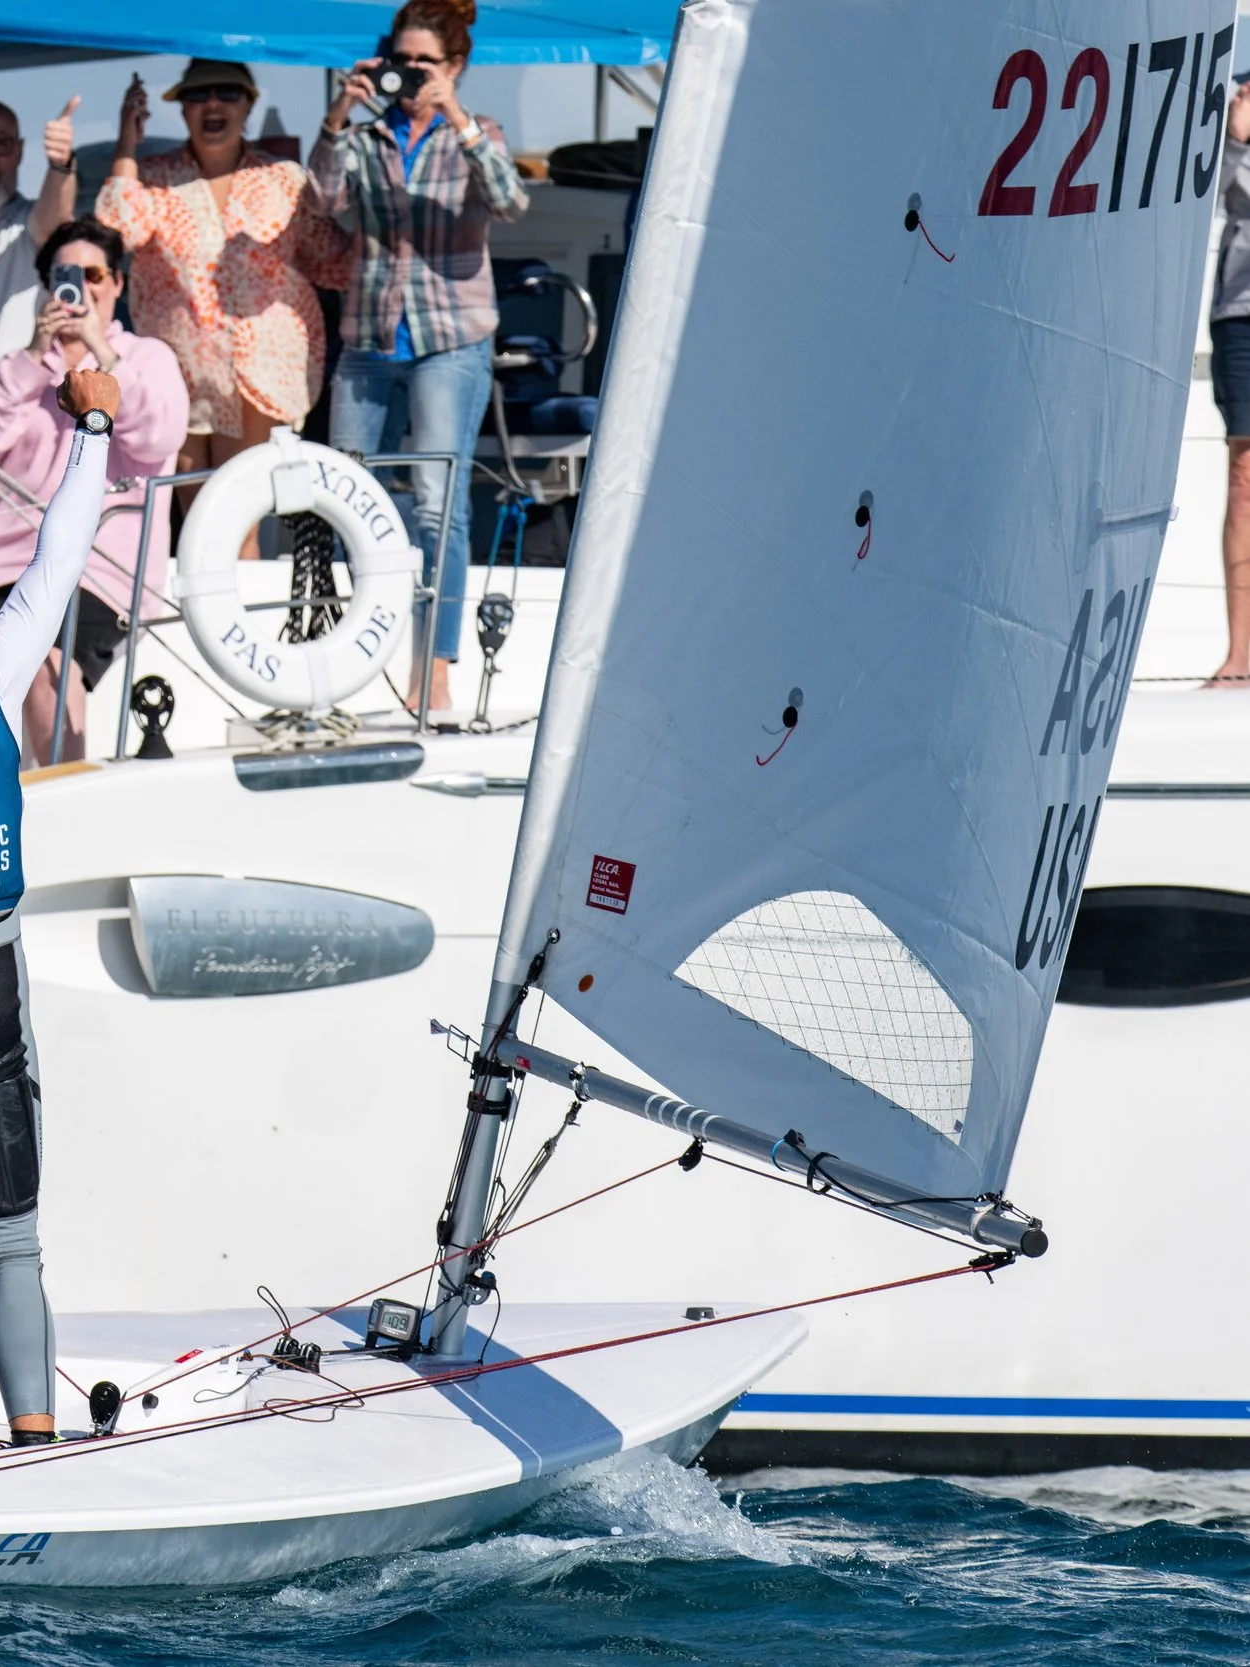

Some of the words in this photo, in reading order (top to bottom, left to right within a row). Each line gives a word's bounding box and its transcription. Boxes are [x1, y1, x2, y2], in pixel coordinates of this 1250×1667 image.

[978, 23, 1235, 217] 221715
[314, 461, 396, 543] DEUX
[220, 622, 282, 682] PAS
[355, 604, 397, 660] DE
[595, 860, 620, 875] ILCA
[166, 908, 379, 937] ELEUTHERA
[387, 1315, 409, 1332] 109
